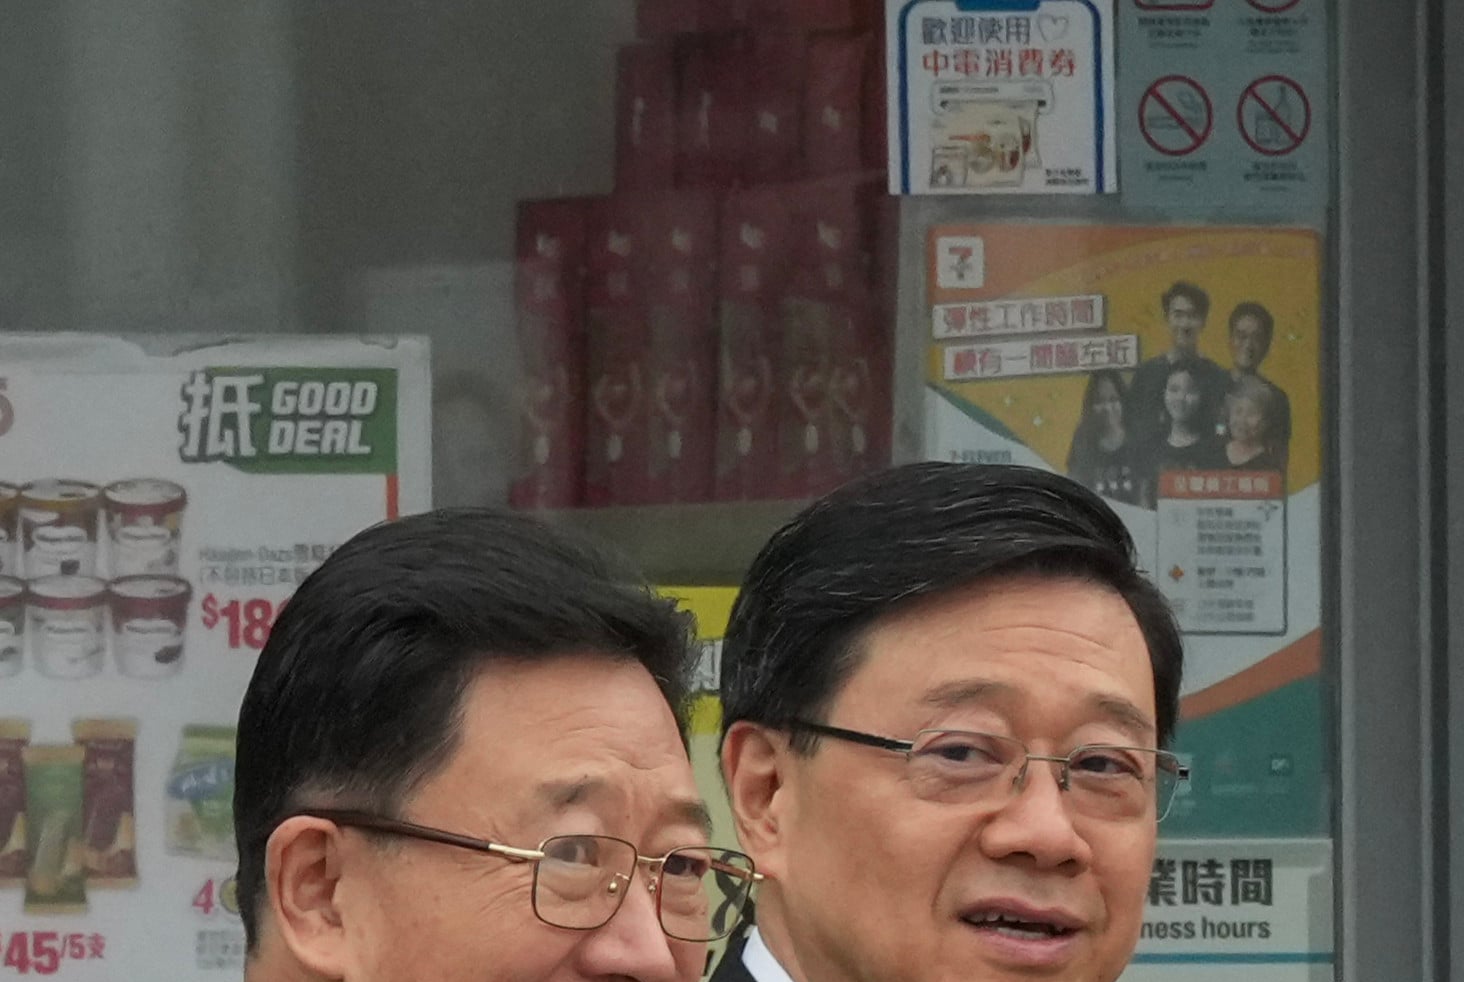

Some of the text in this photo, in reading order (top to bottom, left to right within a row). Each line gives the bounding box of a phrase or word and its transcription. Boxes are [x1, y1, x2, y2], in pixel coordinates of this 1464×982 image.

[922, 15, 1031, 45] 歡迎使用
[922, 48, 1077, 78] 中電消費券
[180, 371, 266, 461] 抵
[271, 380, 378, 416] GOOD
[267, 419, 372, 455] DEAL
[201, 592, 290, 650] $18
[1147, 858, 1273, 906] 業時間
[1201, 917, 1271, 940] hours
[0, 930, 106, 975] 45/5支
